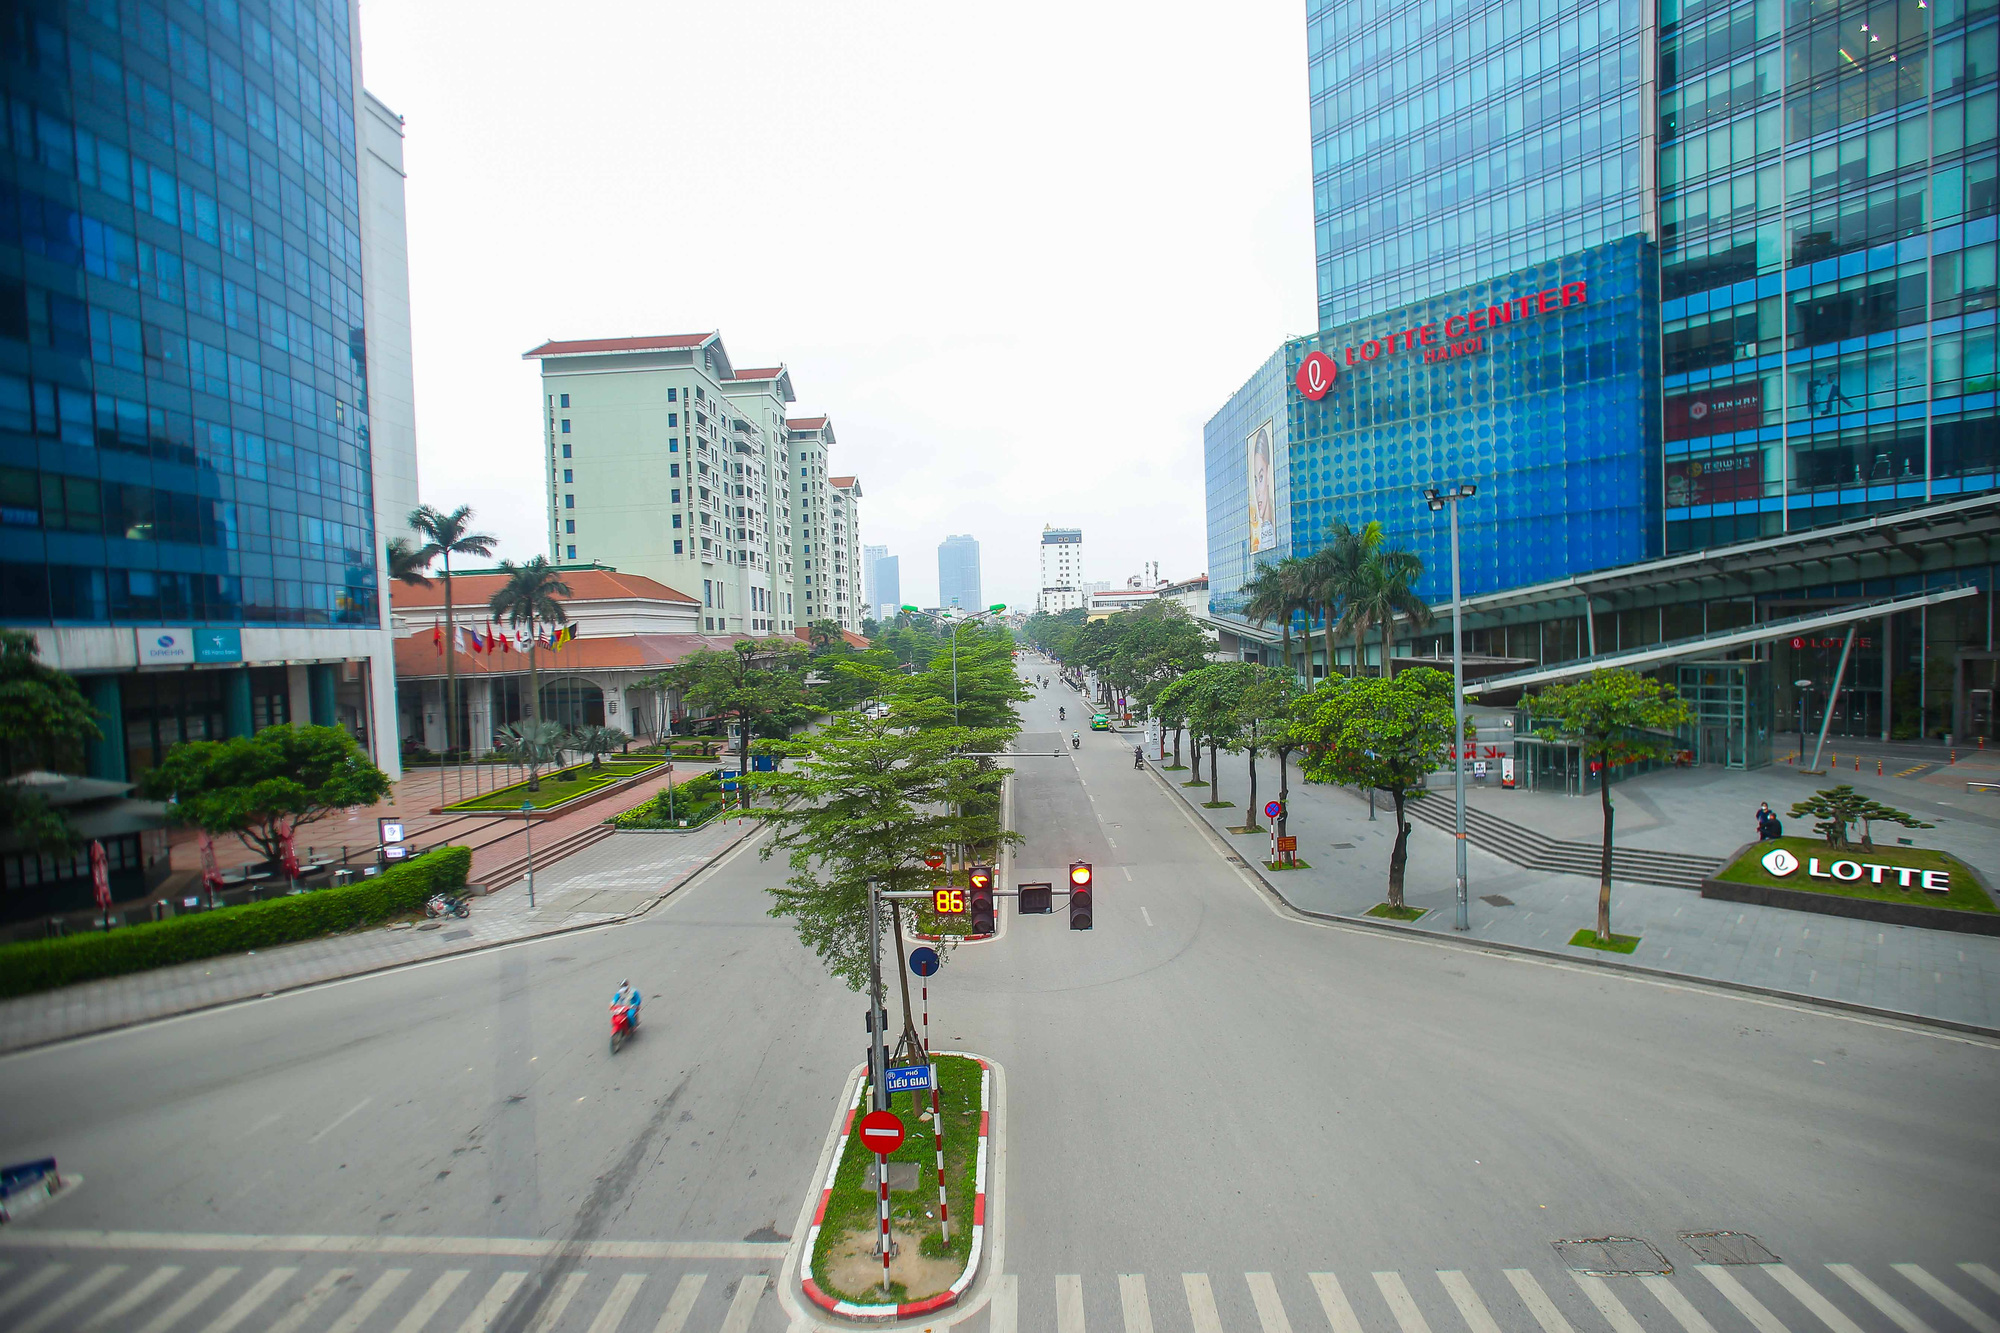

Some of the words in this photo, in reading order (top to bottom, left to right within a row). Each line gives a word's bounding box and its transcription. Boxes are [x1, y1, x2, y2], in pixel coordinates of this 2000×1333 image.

[1345, 323, 1437, 366] LOTTE
[1445, 281, 1587, 338] CENTER
[1424, 336, 1483, 365] HANOI
[1808, 857, 1950, 892] LOTTE
[936, 890, 964, 913] 86
[910, 1077, 928, 1087] GIAI
